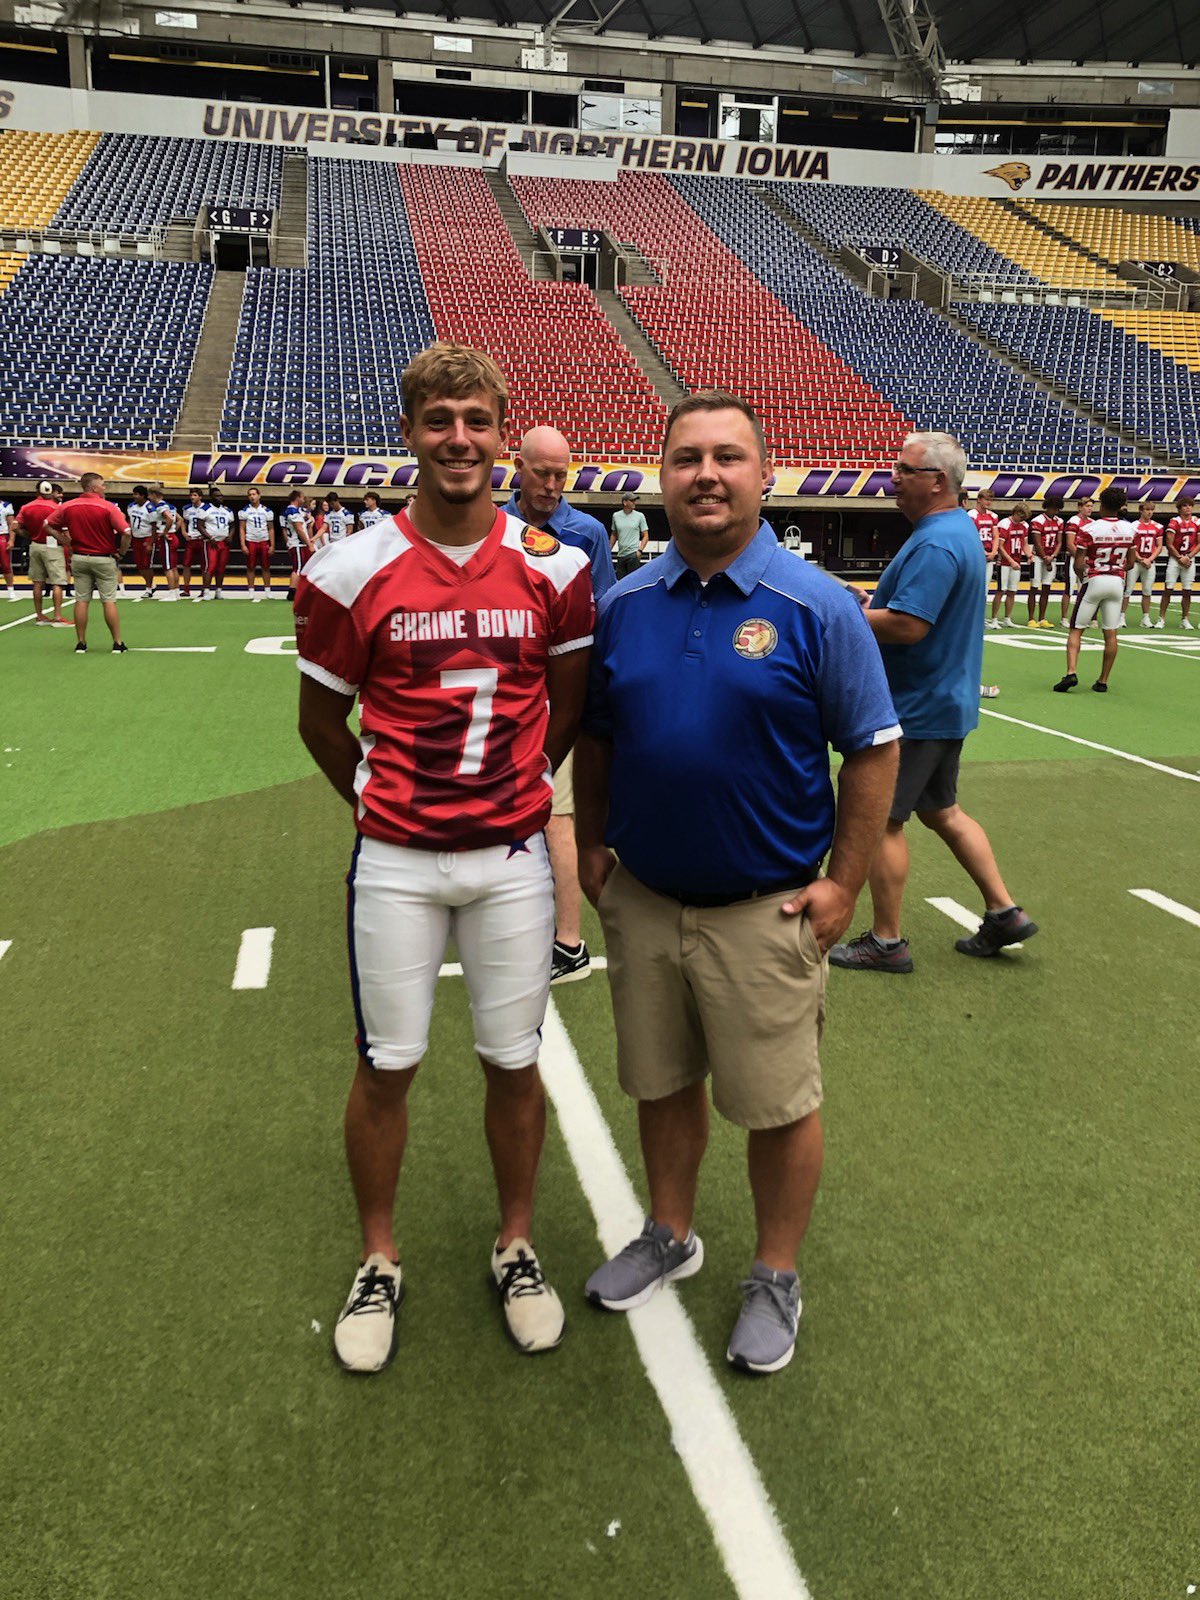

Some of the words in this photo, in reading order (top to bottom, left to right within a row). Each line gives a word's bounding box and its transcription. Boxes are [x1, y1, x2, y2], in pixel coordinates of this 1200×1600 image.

[203, 104, 448, 147] UNIVERSITY
[456, 126, 507, 157] OF
[521, 129, 727, 174] NORTHERN
[735, 145, 830, 181] IOWA
[1034, 162, 1200, 192] PANTHERS
[221, 209, 231, 225] G
[250, 211, 259, 227] F
[557, 230, 565, 244] F
[581, 231, 589, 246] E
[881, 249, 890, 263] D
[572, 465, 644, 492] to
[390, 609, 468, 642] SHRINE
[476, 608, 537, 638] BOWL
[439, 667, 498, 775] 7
